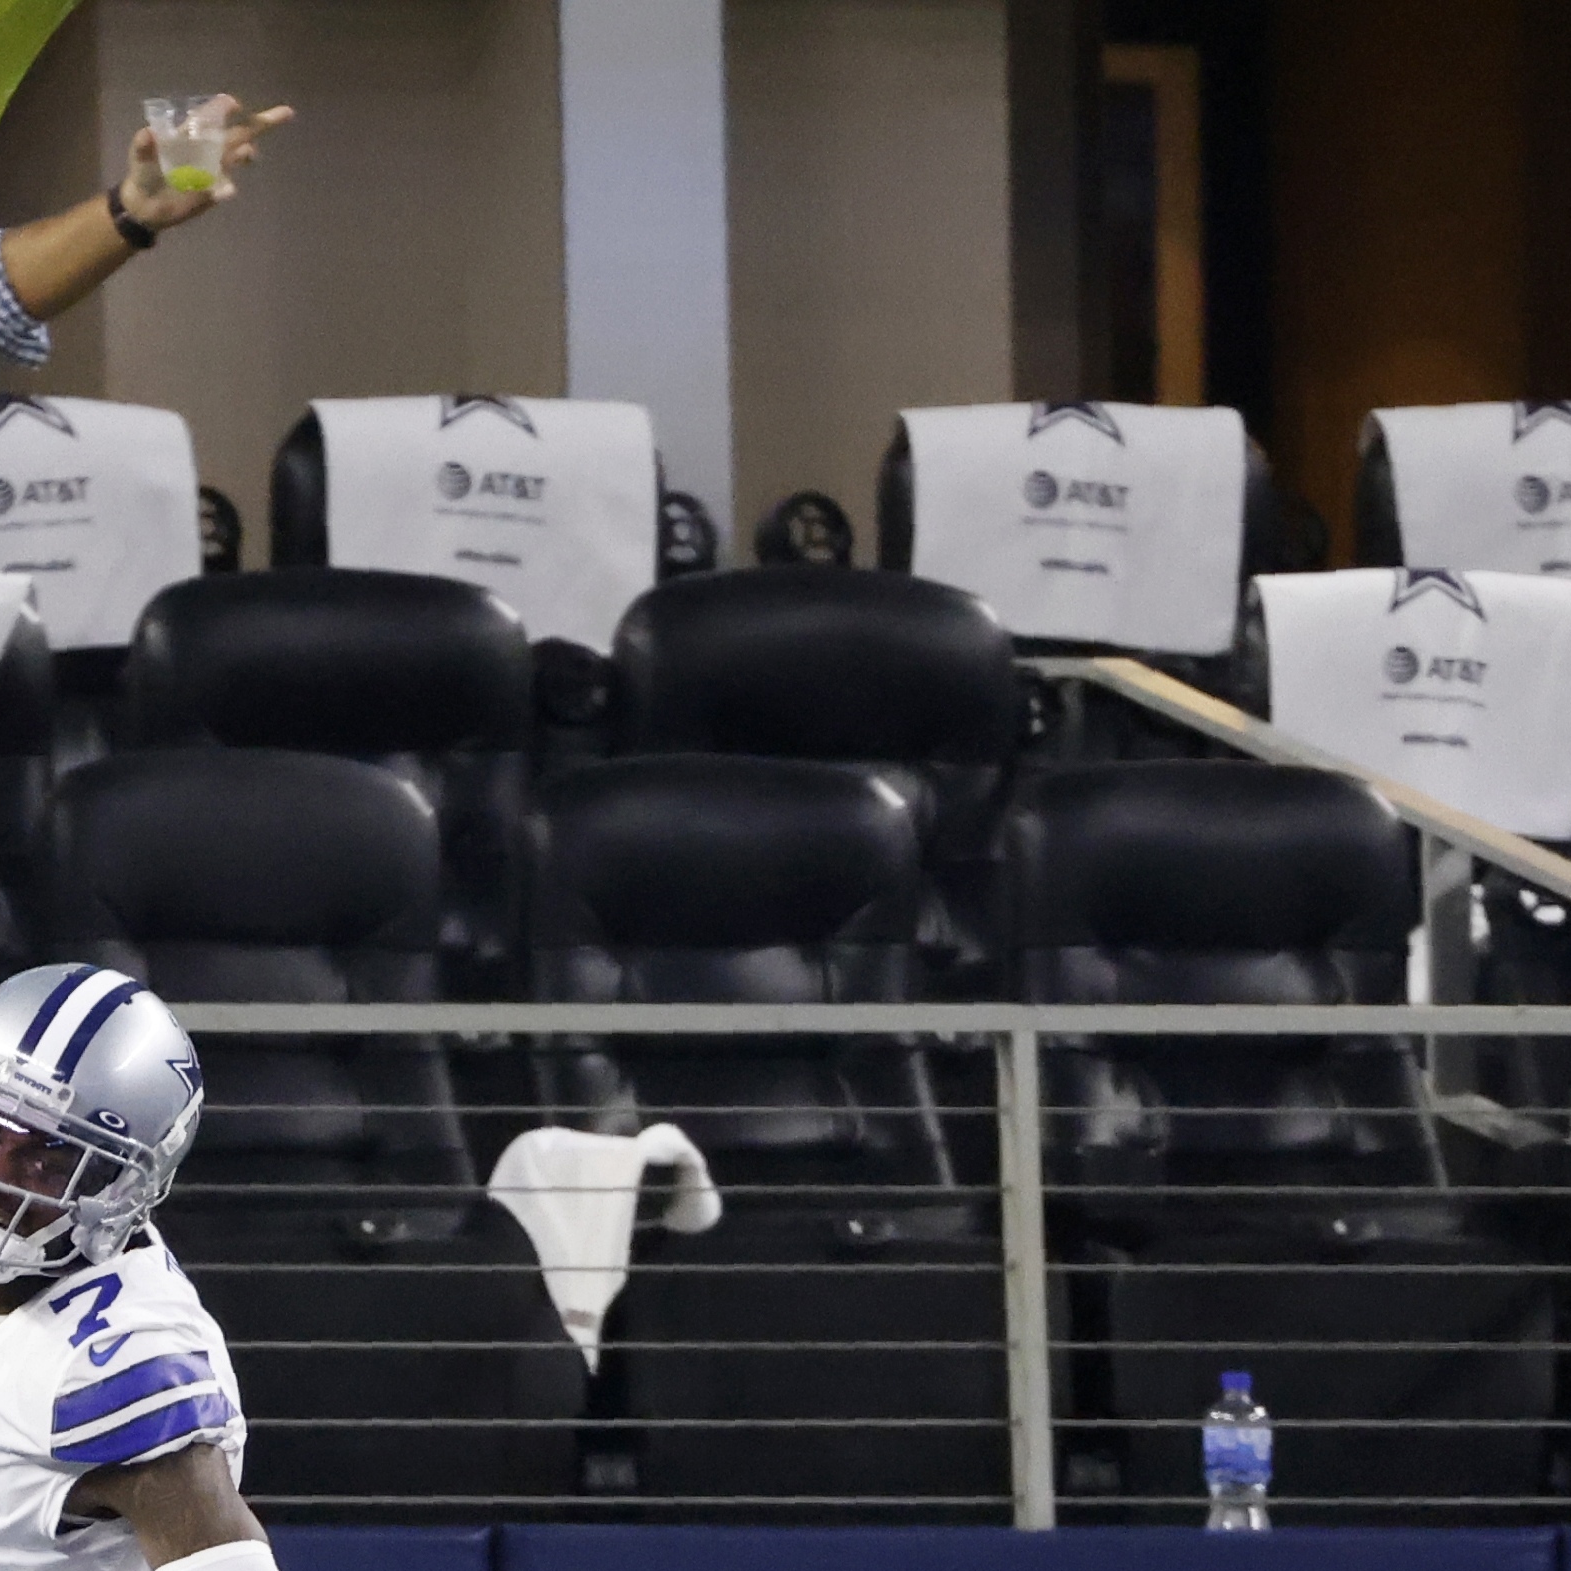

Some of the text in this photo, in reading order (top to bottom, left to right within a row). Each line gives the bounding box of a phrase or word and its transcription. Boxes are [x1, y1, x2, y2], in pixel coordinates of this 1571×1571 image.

[22, 476, 91, 503] AT&T
[479, 471, 546, 500] AT&T
[1066, 479, 1129, 509] AT&T
[1427, 656, 1487, 685] AT&T
[49, 1272, 124, 1350] 7
